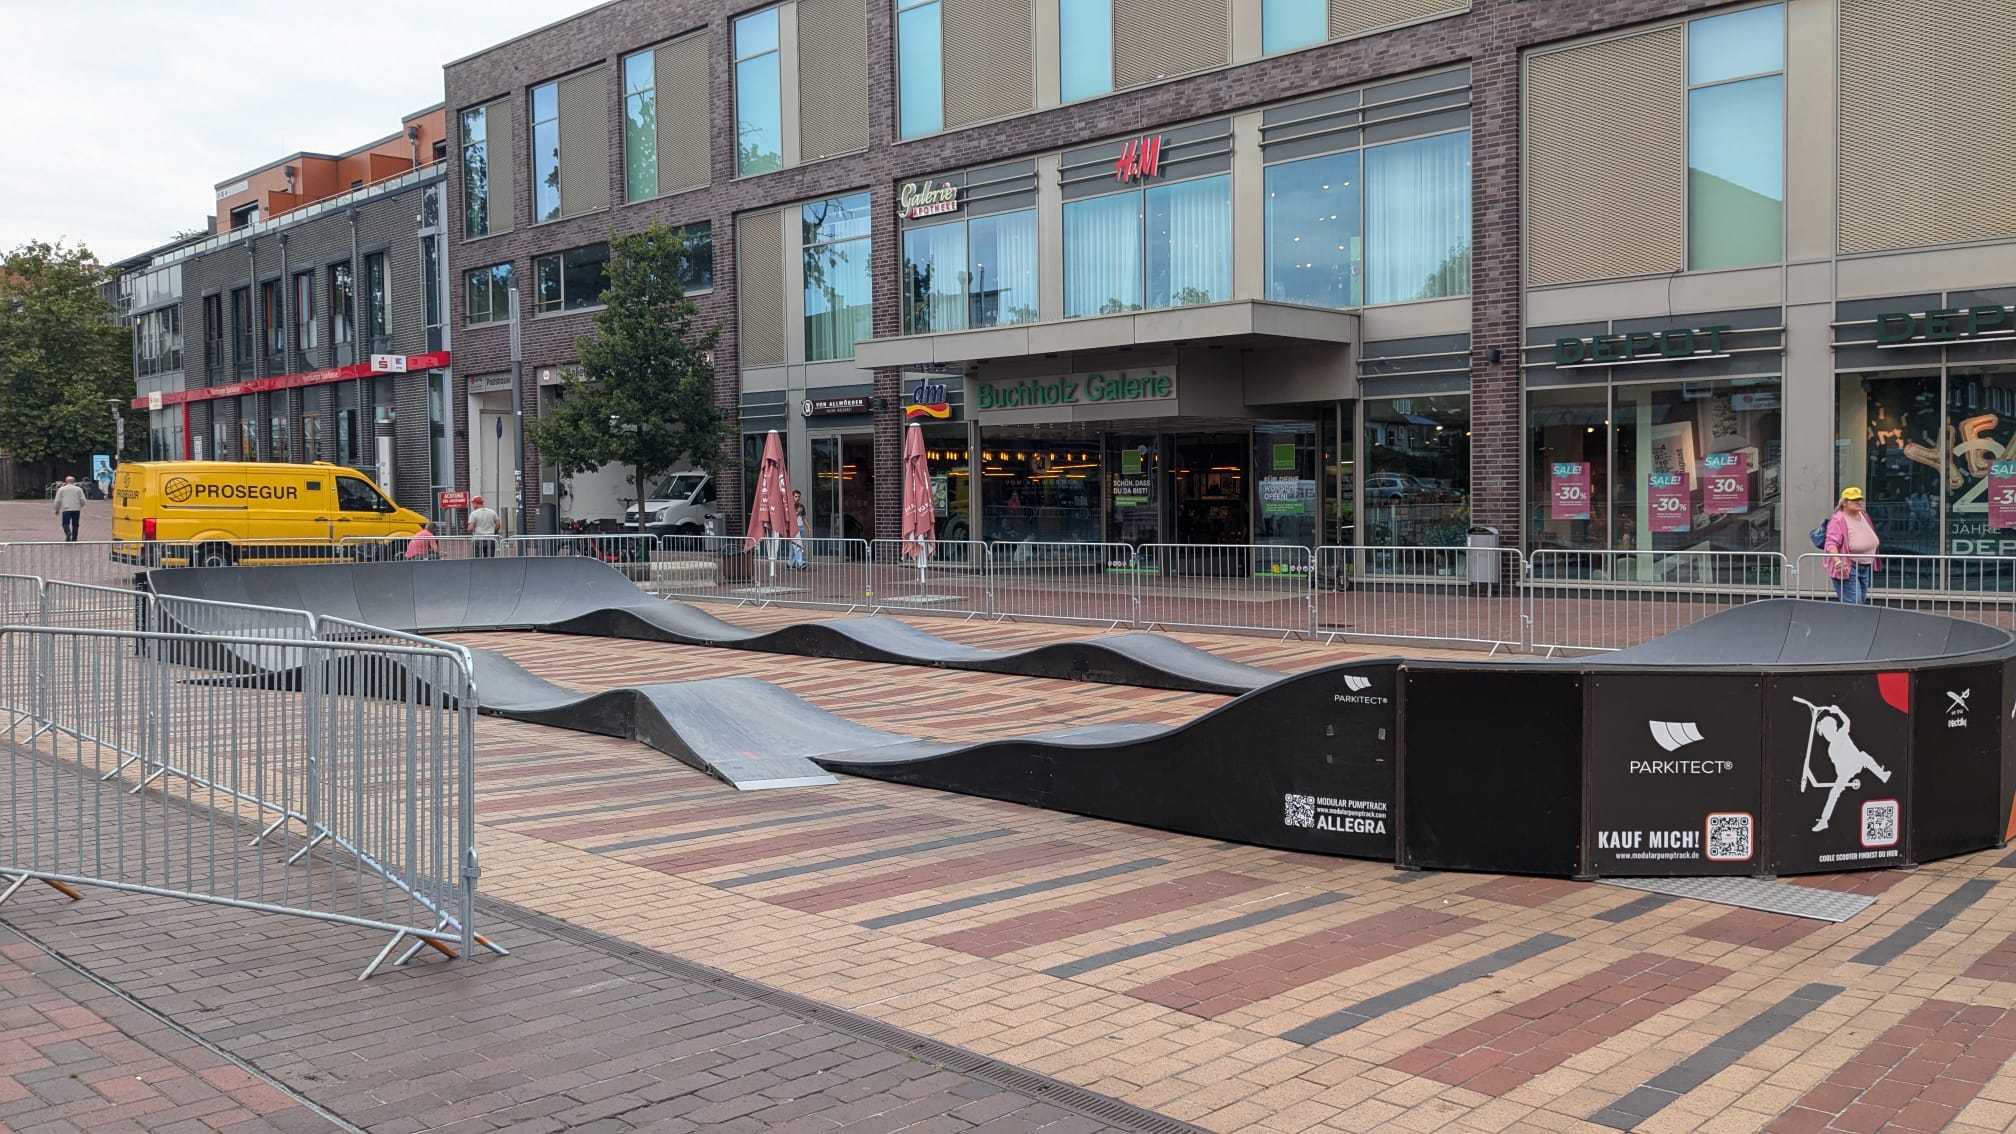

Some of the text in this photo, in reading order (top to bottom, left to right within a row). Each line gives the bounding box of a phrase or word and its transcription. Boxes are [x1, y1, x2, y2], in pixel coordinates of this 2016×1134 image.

[1115, 135, 1161, 183] H&M
[899, 180, 957, 214] Galerie
[911, 201, 957, 218] APOTHEKE
[1877, 305, 2016, 342] DEP
[1555, 325, 1731, 364] DEPOT
[913, 378, 947, 404] dm
[977, 370, 1172, 409] Buchholz Galerie
[1704, 455, 1738, 466] SALE!
[1552, 465, 1582, 475] SALE!
[1649, 475, 1681, 486] SALE!
[1707, 479, 1744, 493] -30%
[195, 484, 297, 500] PROSEGUR
[1555, 486, 1587, 500] -30%
[1652, 497, 1687, 511] -30%
[1317, 796, 1387, 811] MODULAR PUMPTRACK
[1316, 807, 1387, 819] www.modularpumptrack.com
[1317, 814, 1386, 834] ALLEGRA
[1598, 830, 1700, 849] KAUF MICH!
[1615, 851, 1700, 861] www.modularpumptrack.de
[1819, 854, 1835, 862] COOLE
[1836, 852, 1858, 861] SCOOTER
[1858, 851, 1877, 860] FINDEST
[1878, 850, 1886, 858] DU
